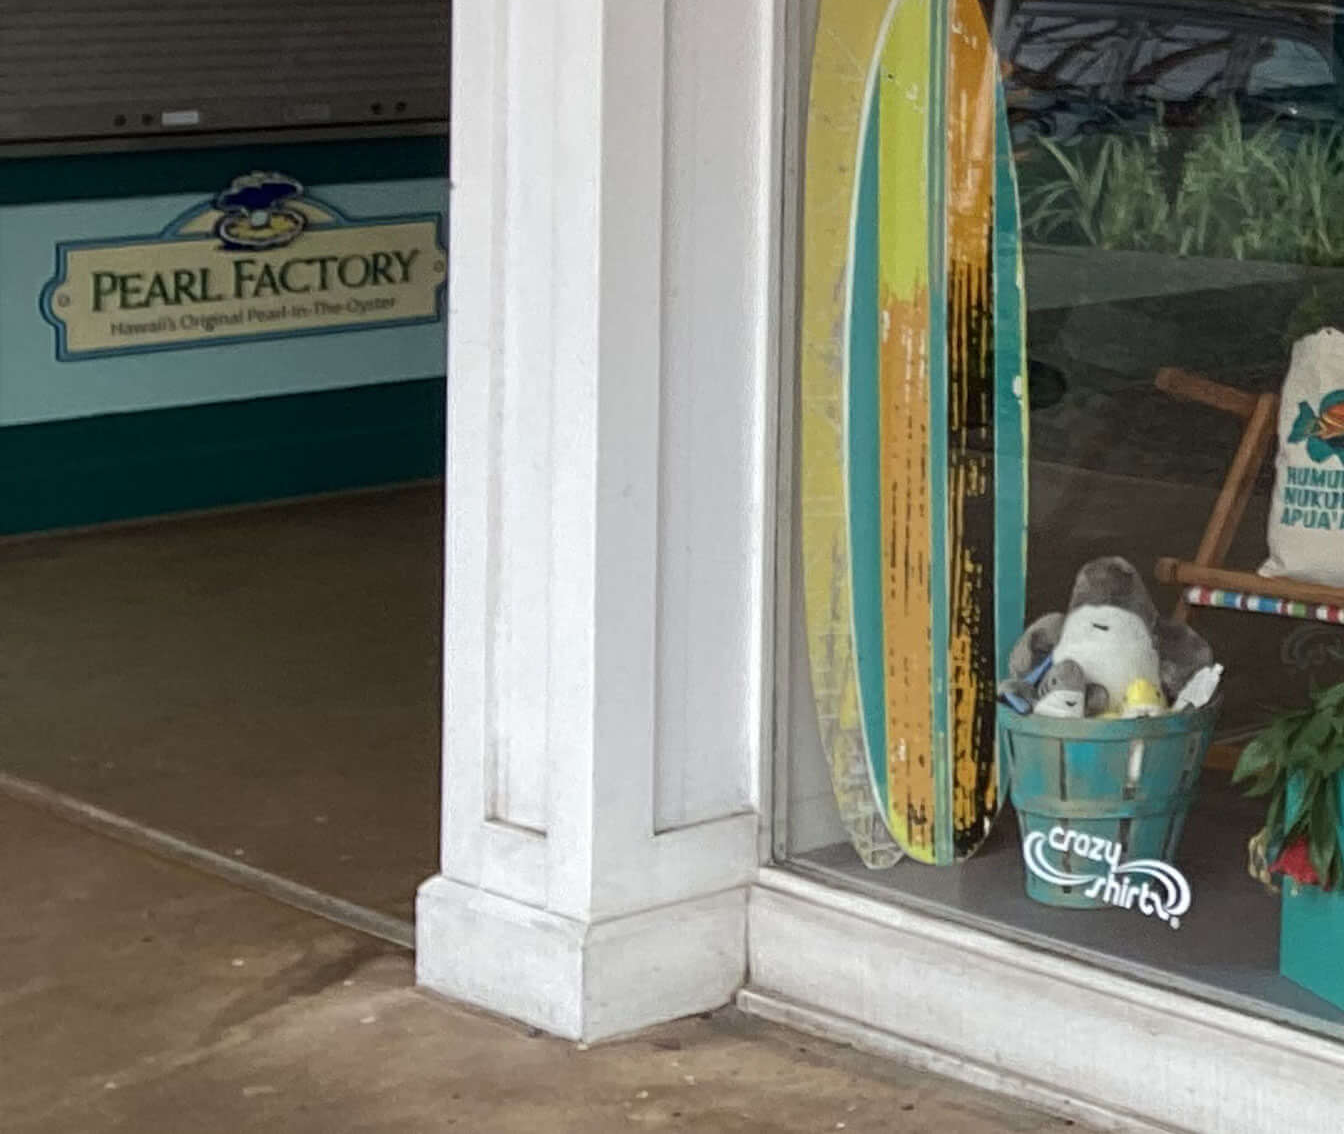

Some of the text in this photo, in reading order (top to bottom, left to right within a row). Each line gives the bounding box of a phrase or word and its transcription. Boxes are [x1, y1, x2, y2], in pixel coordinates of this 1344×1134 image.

[91, 248, 420, 312] PEARL FACTORY
[179, 309, 244, 332] Original
[1049, 826, 1122, 866] crazy
